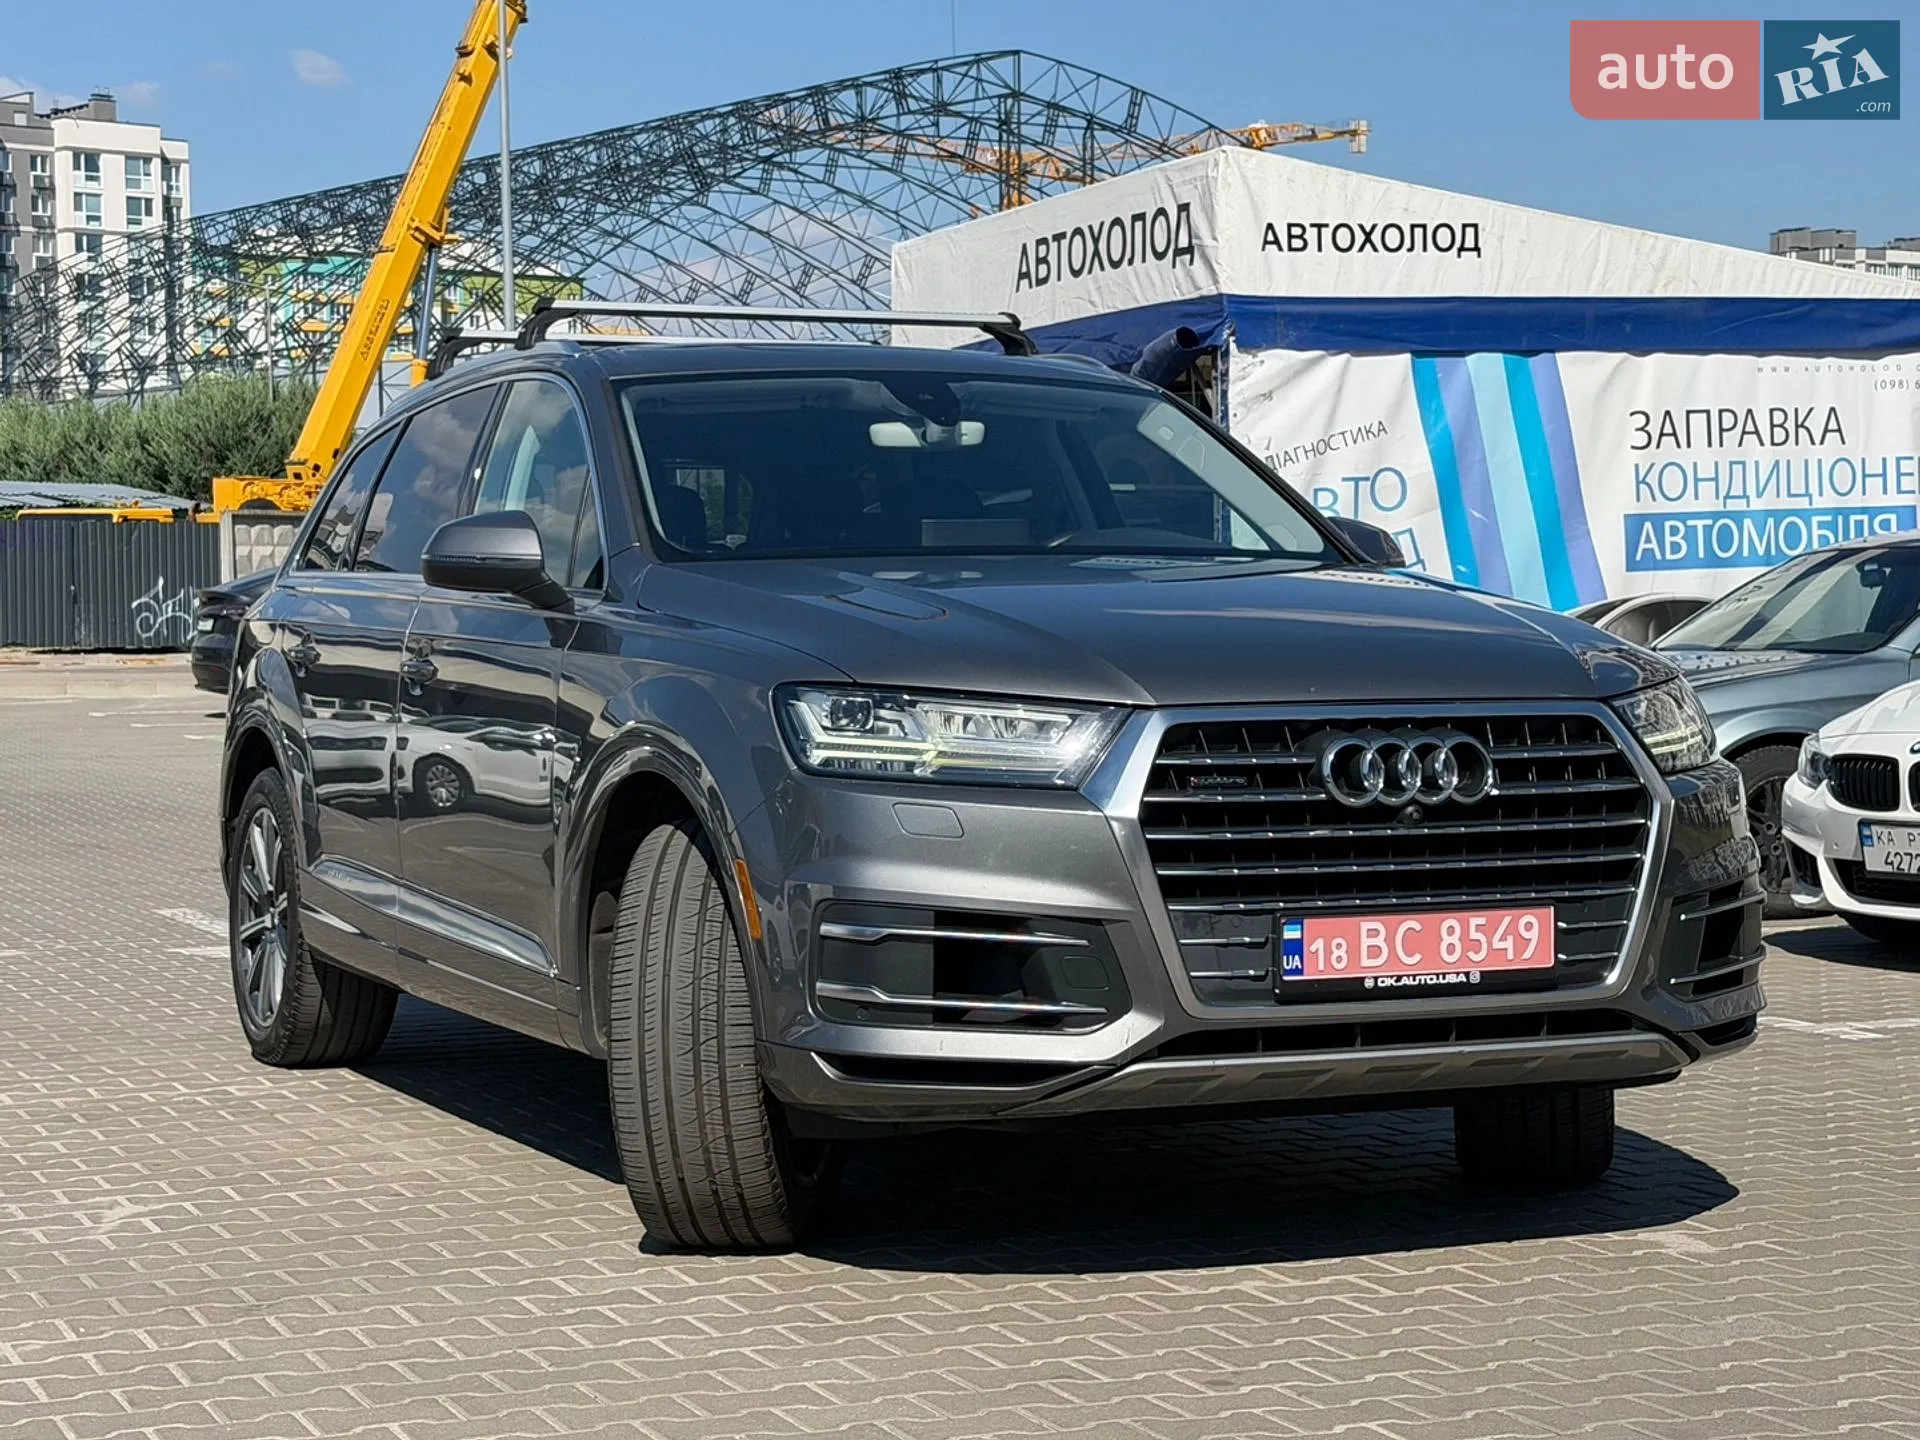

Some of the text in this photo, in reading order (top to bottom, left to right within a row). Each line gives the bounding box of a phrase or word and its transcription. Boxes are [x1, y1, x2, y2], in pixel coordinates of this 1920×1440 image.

[1015, 202, 1194, 293] АВТОХОЛОД
[1261, 222, 1482, 259] АВТОХОЛОД
[1873, 379, 1910, 392] (098)
[1629, 406, 1846, 450] ЗАПРАВКА
[1313, 467, 1408, 520] ВТО
[1634, 456, 1920, 509] КОНДИЦІОНЕ
[1876, 830, 1896, 846] KA
[1283, 955, 1302, 970] UA
[1308, 914, 1540, 972] 18 BC 8549
[1377, 973, 1467, 987] OK.AUTO.USA
